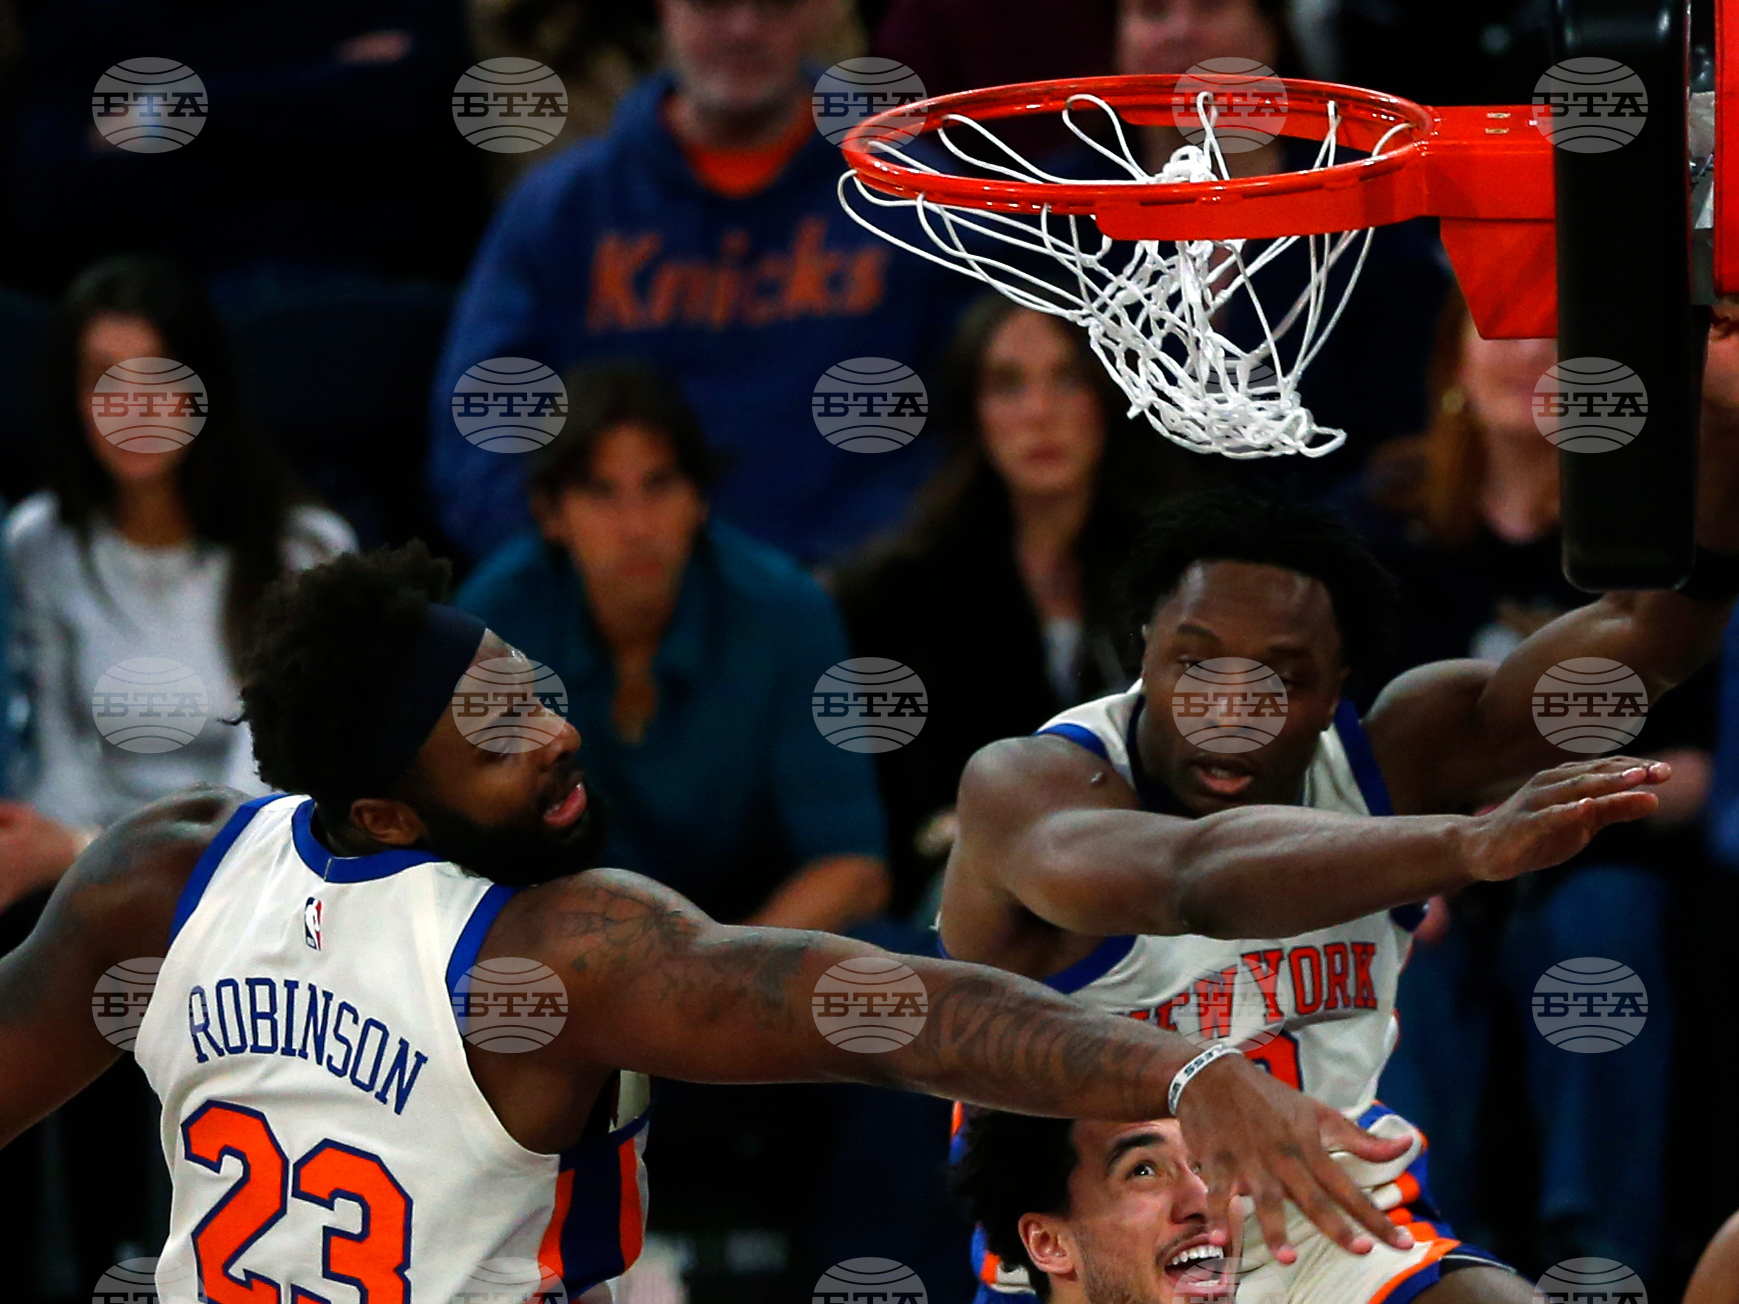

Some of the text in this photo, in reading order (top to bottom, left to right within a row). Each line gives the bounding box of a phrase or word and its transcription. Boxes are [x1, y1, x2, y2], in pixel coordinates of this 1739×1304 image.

[588, 215, 886, 332] Knicks
[189, 976, 428, 1115] ROBINSON
[1111, 942, 1378, 1038] EW YORK
